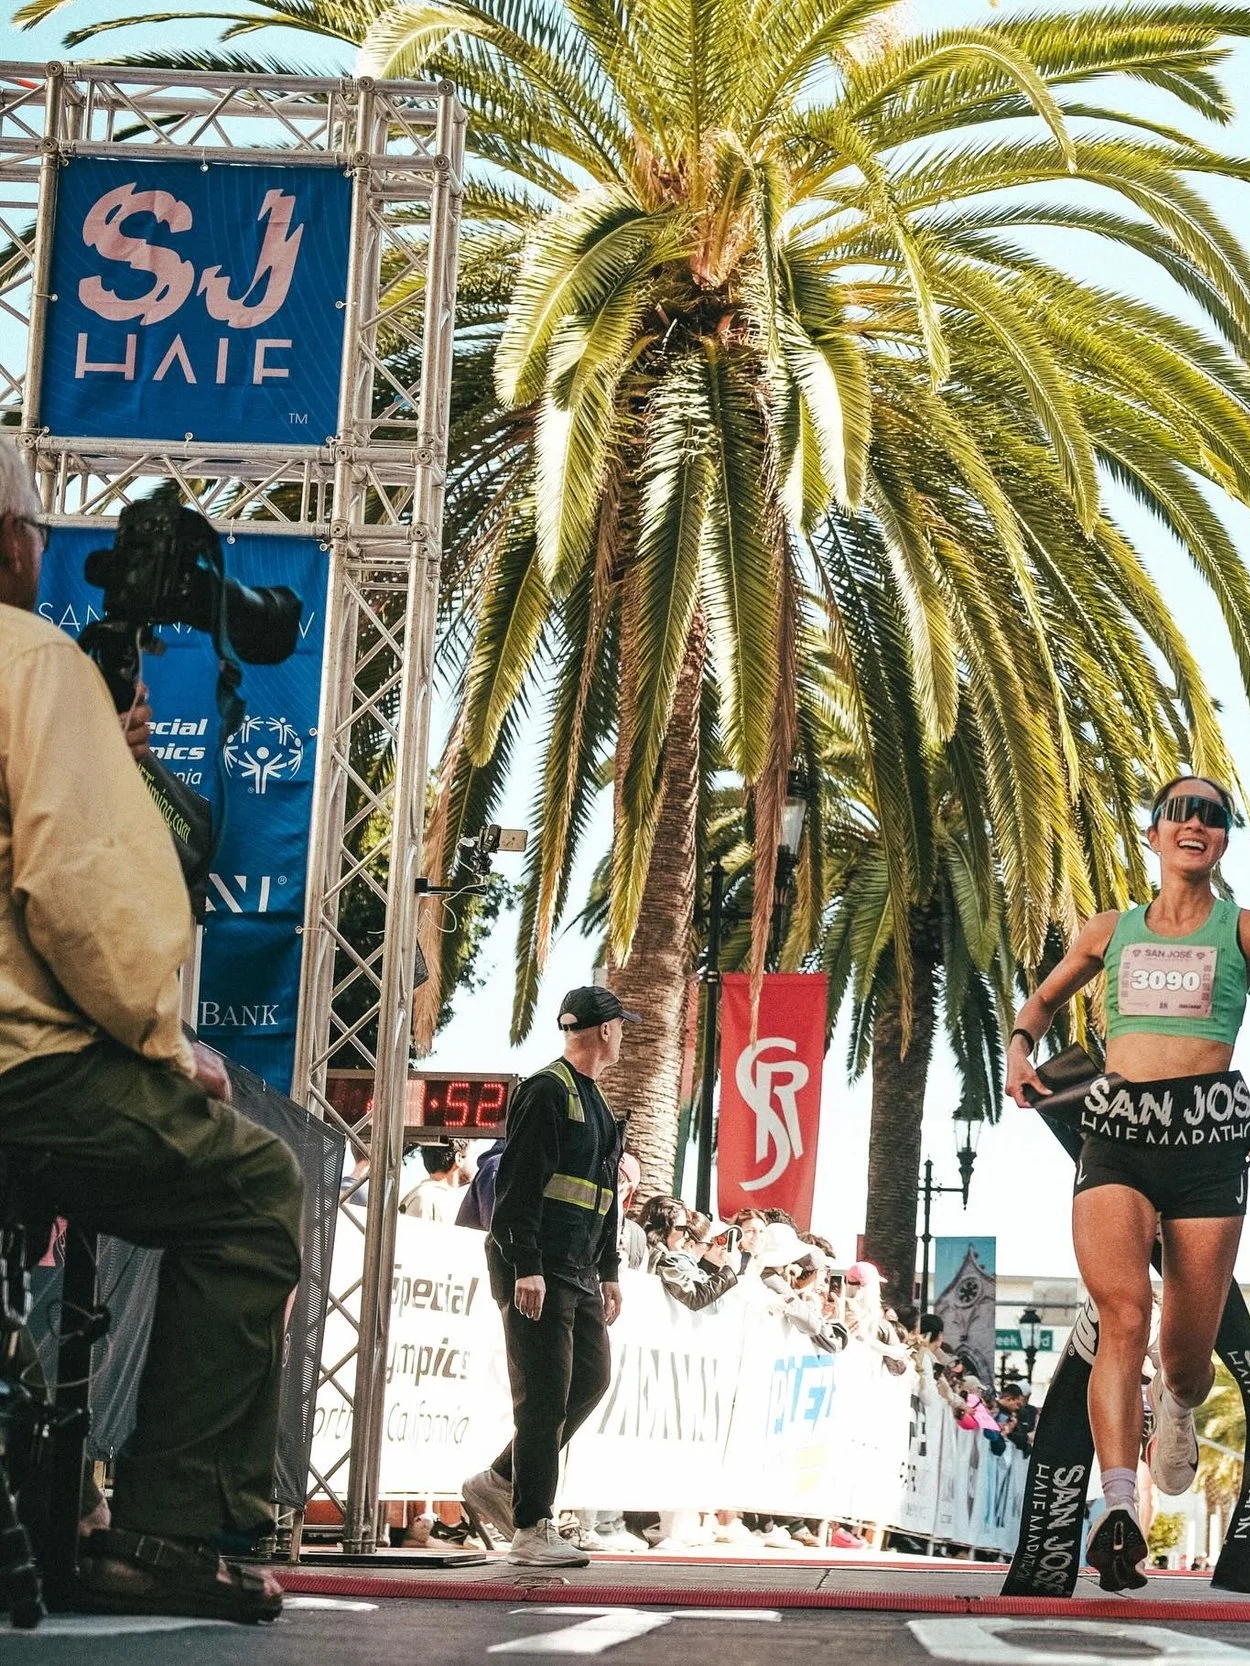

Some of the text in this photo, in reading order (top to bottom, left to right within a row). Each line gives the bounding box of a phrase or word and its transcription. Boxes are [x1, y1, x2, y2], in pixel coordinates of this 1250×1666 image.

[78, 182, 304, 329] SJ
[288, 413, 308, 424] TM
[145, 718, 208, 736] ecial
[1144, 949, 1165, 957] SAN
[1130, 969, 1200, 992] 3090
[199, 1001, 279, 1026] BANK
[1084, 1076, 1174, 1127] SAN
[995, 1334, 1018, 1347] eek
[386, 1337, 470, 1386] ympics
[1047, 1464, 1085, 1530] SAN
